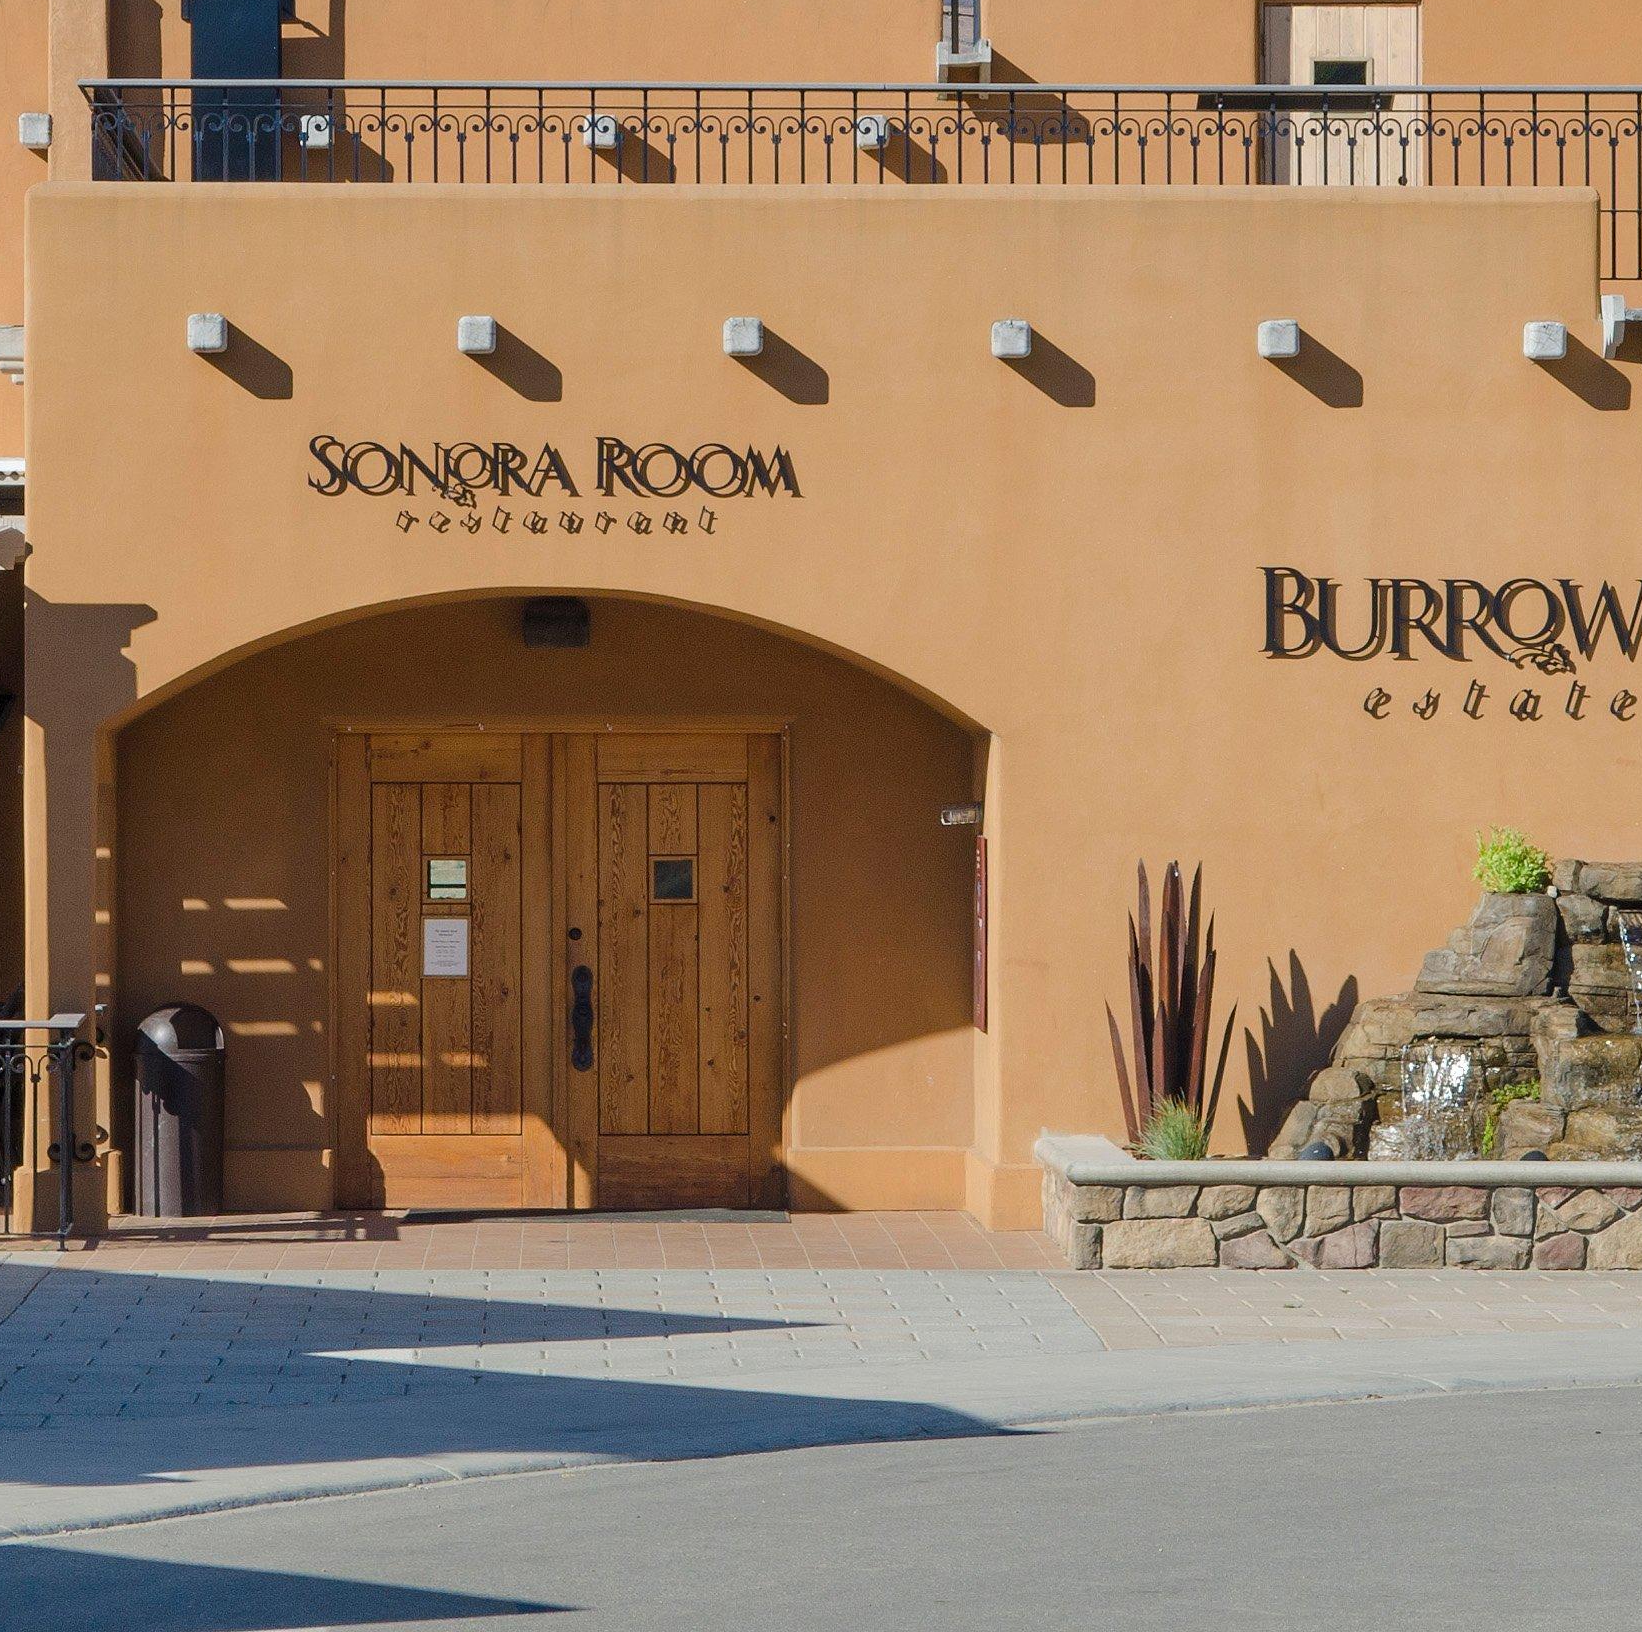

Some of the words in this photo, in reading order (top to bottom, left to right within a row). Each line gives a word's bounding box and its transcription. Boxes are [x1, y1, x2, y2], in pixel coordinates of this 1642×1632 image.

[307, 434, 581, 498] SONORA
[594, 436, 805, 499] ROOM
[395, 505, 719, 536] restaurant
[1363, 680, 1639, 722] estate
